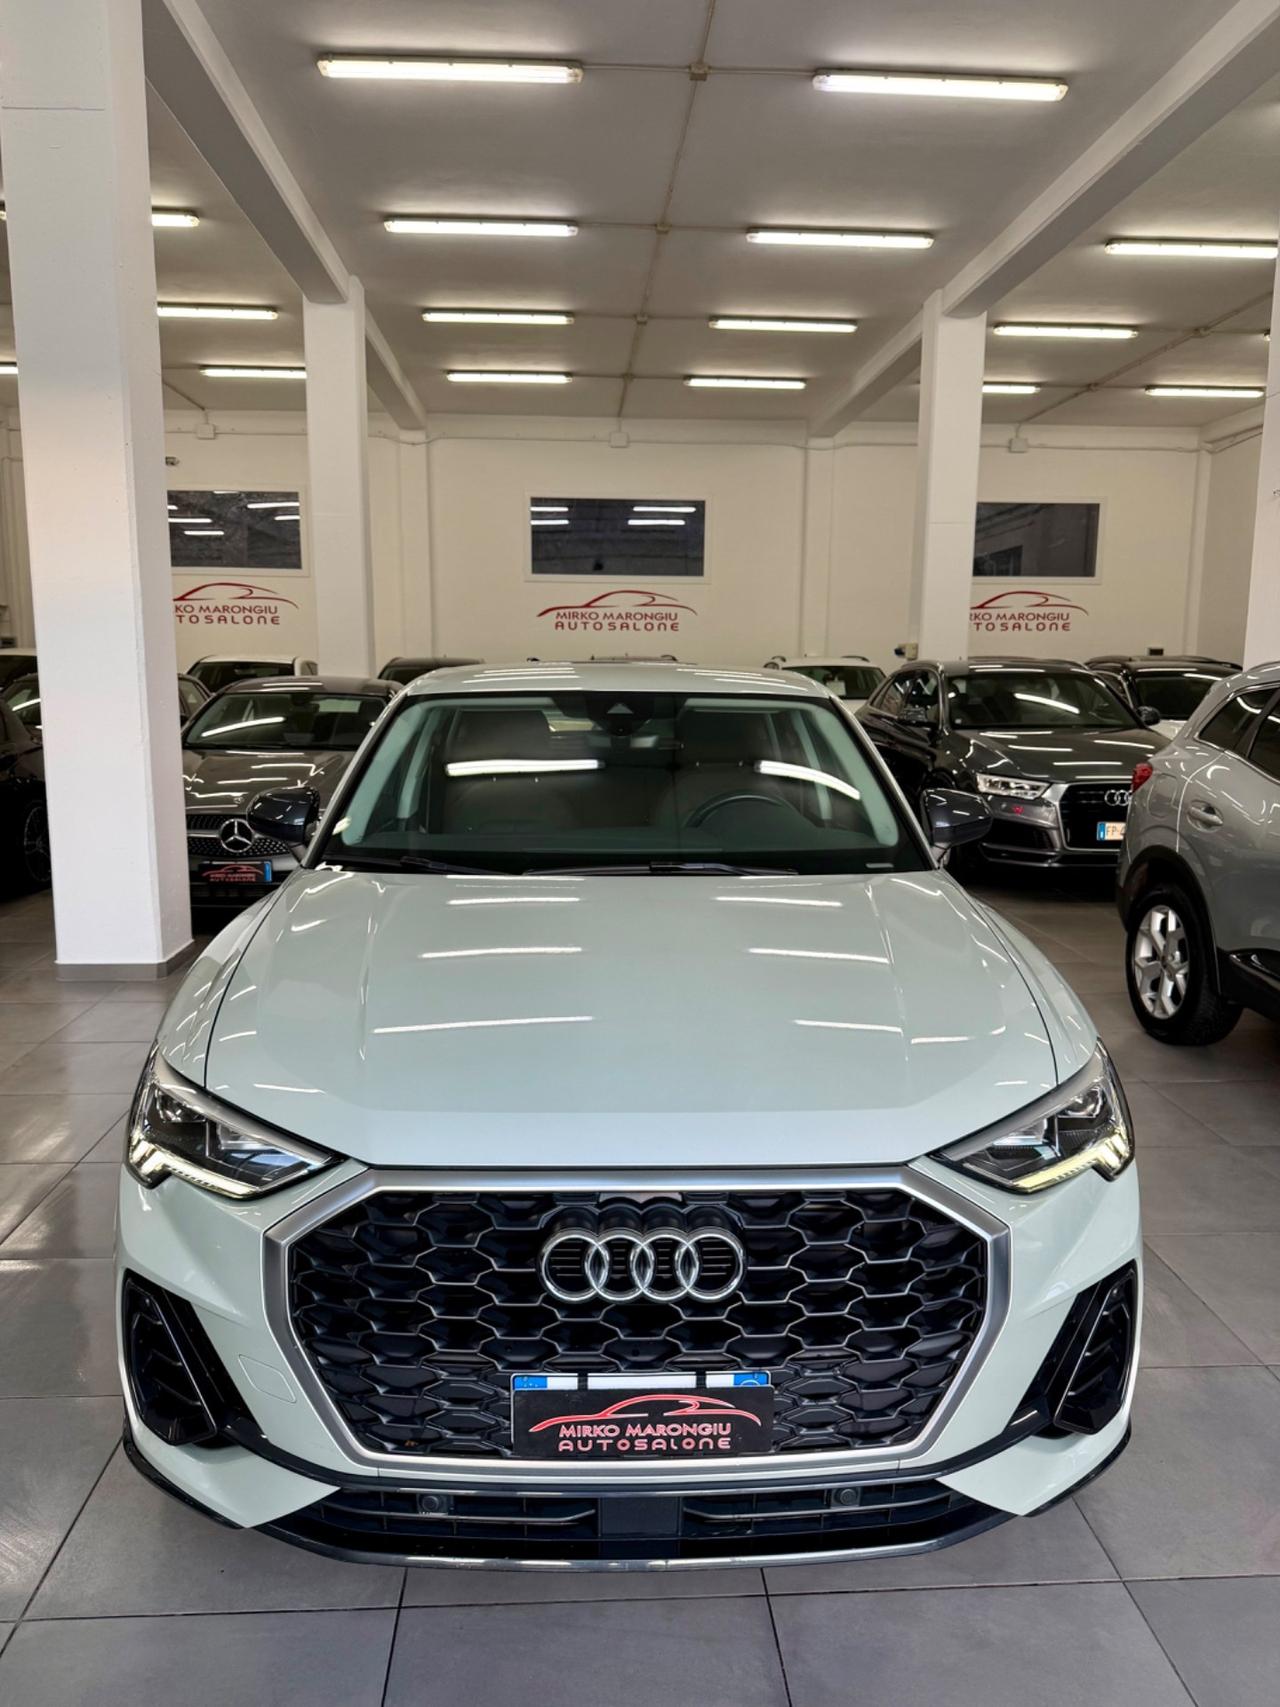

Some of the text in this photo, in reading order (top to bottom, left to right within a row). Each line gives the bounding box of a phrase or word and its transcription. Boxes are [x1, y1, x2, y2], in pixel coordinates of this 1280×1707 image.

[198, 604, 278, 615] MARONGIU
[555, 611, 678, 621] MIRKO MARONGIU
[995, 612, 1070, 622] MARONGIU
[554, 621, 679, 631] AUTOSALONE
[558, 1422, 732, 1438] MIRKO MARONGIU
[558, 1437, 732, 1452] AUTOSALONE
